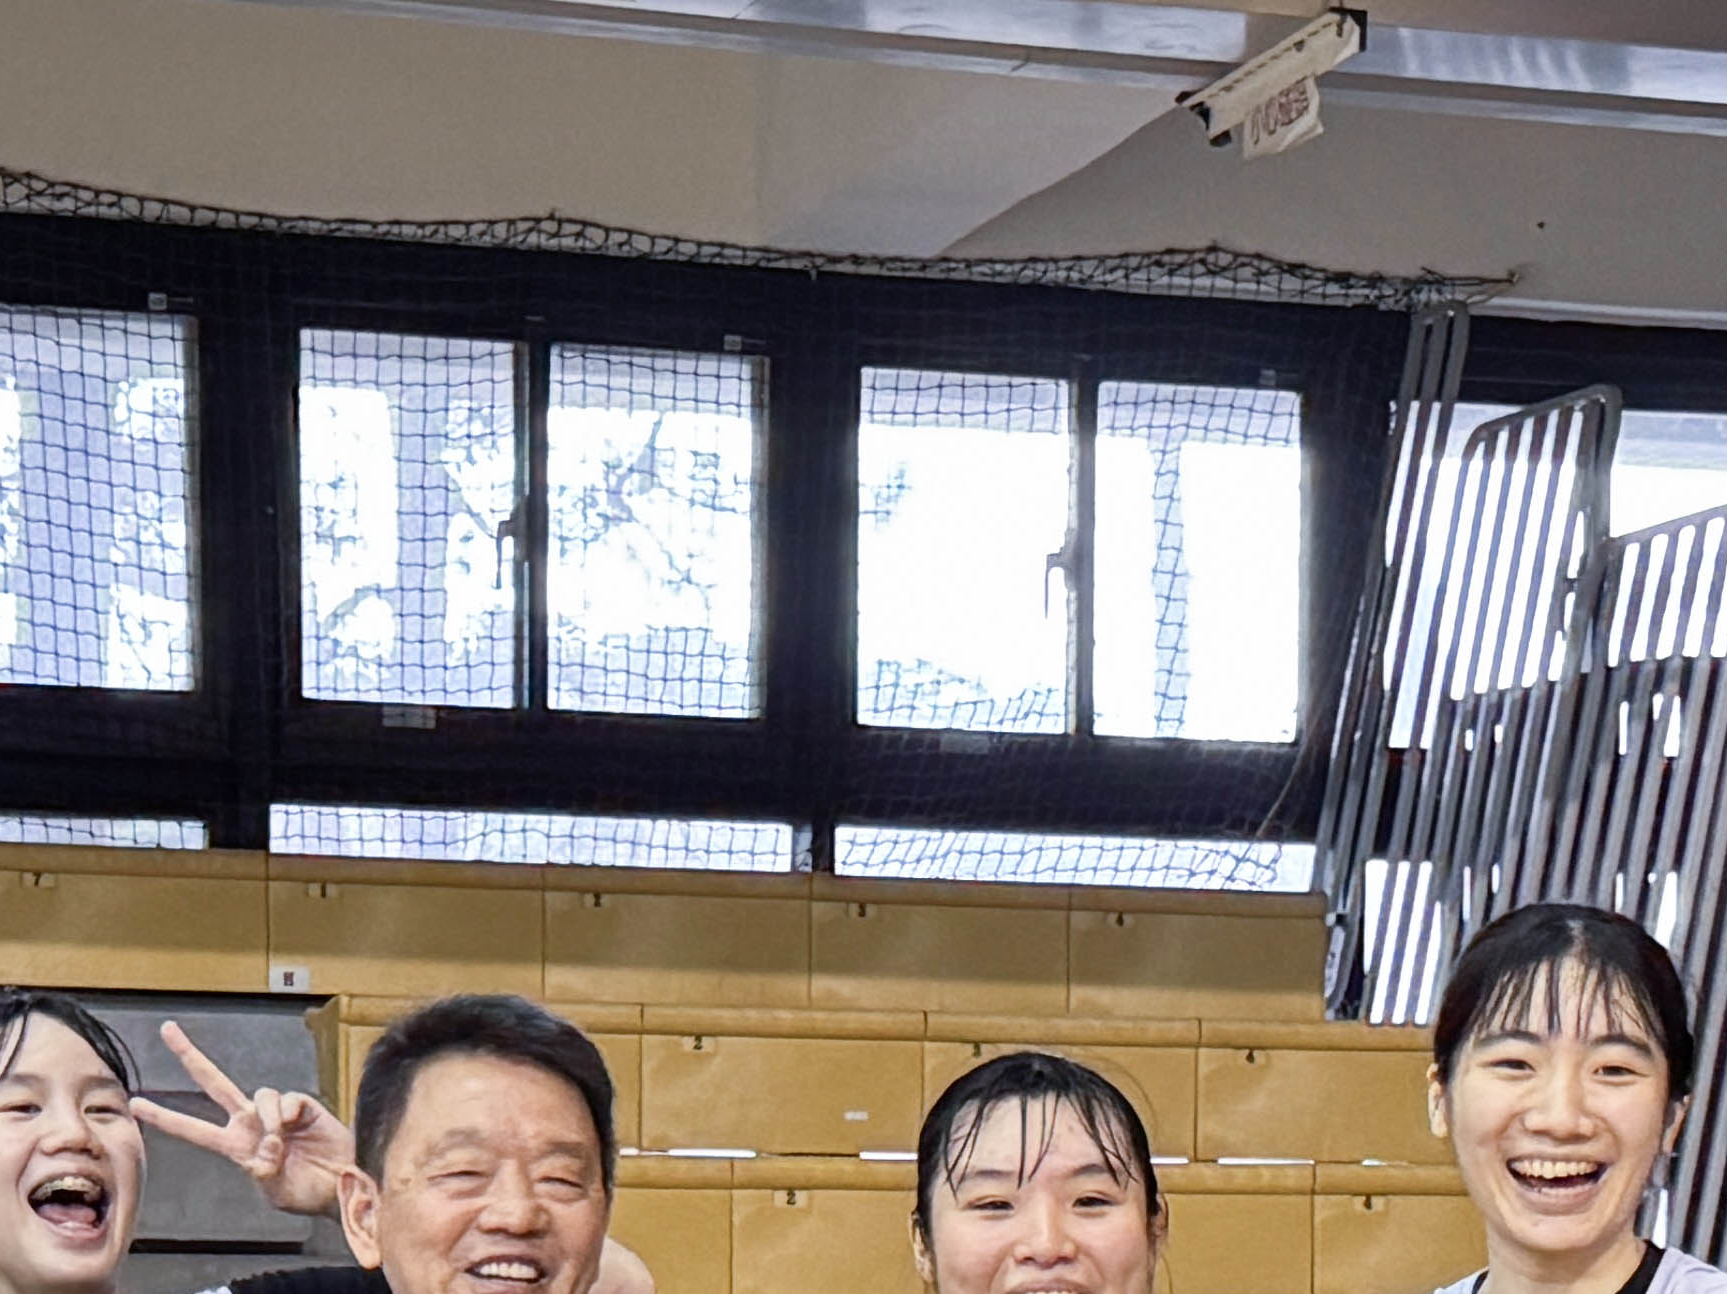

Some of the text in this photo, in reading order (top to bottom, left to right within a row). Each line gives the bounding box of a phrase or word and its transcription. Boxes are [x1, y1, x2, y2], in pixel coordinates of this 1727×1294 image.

[32, 873, 42, 888] 7
[1115, 912, 1124, 927] 4
[693, 1036, 703, 1051] 2
[1246, 1049, 1255, 1064] 4
[786, 1190, 797, 1206] 2
[1363, 1195, 1373, 1211] 4
